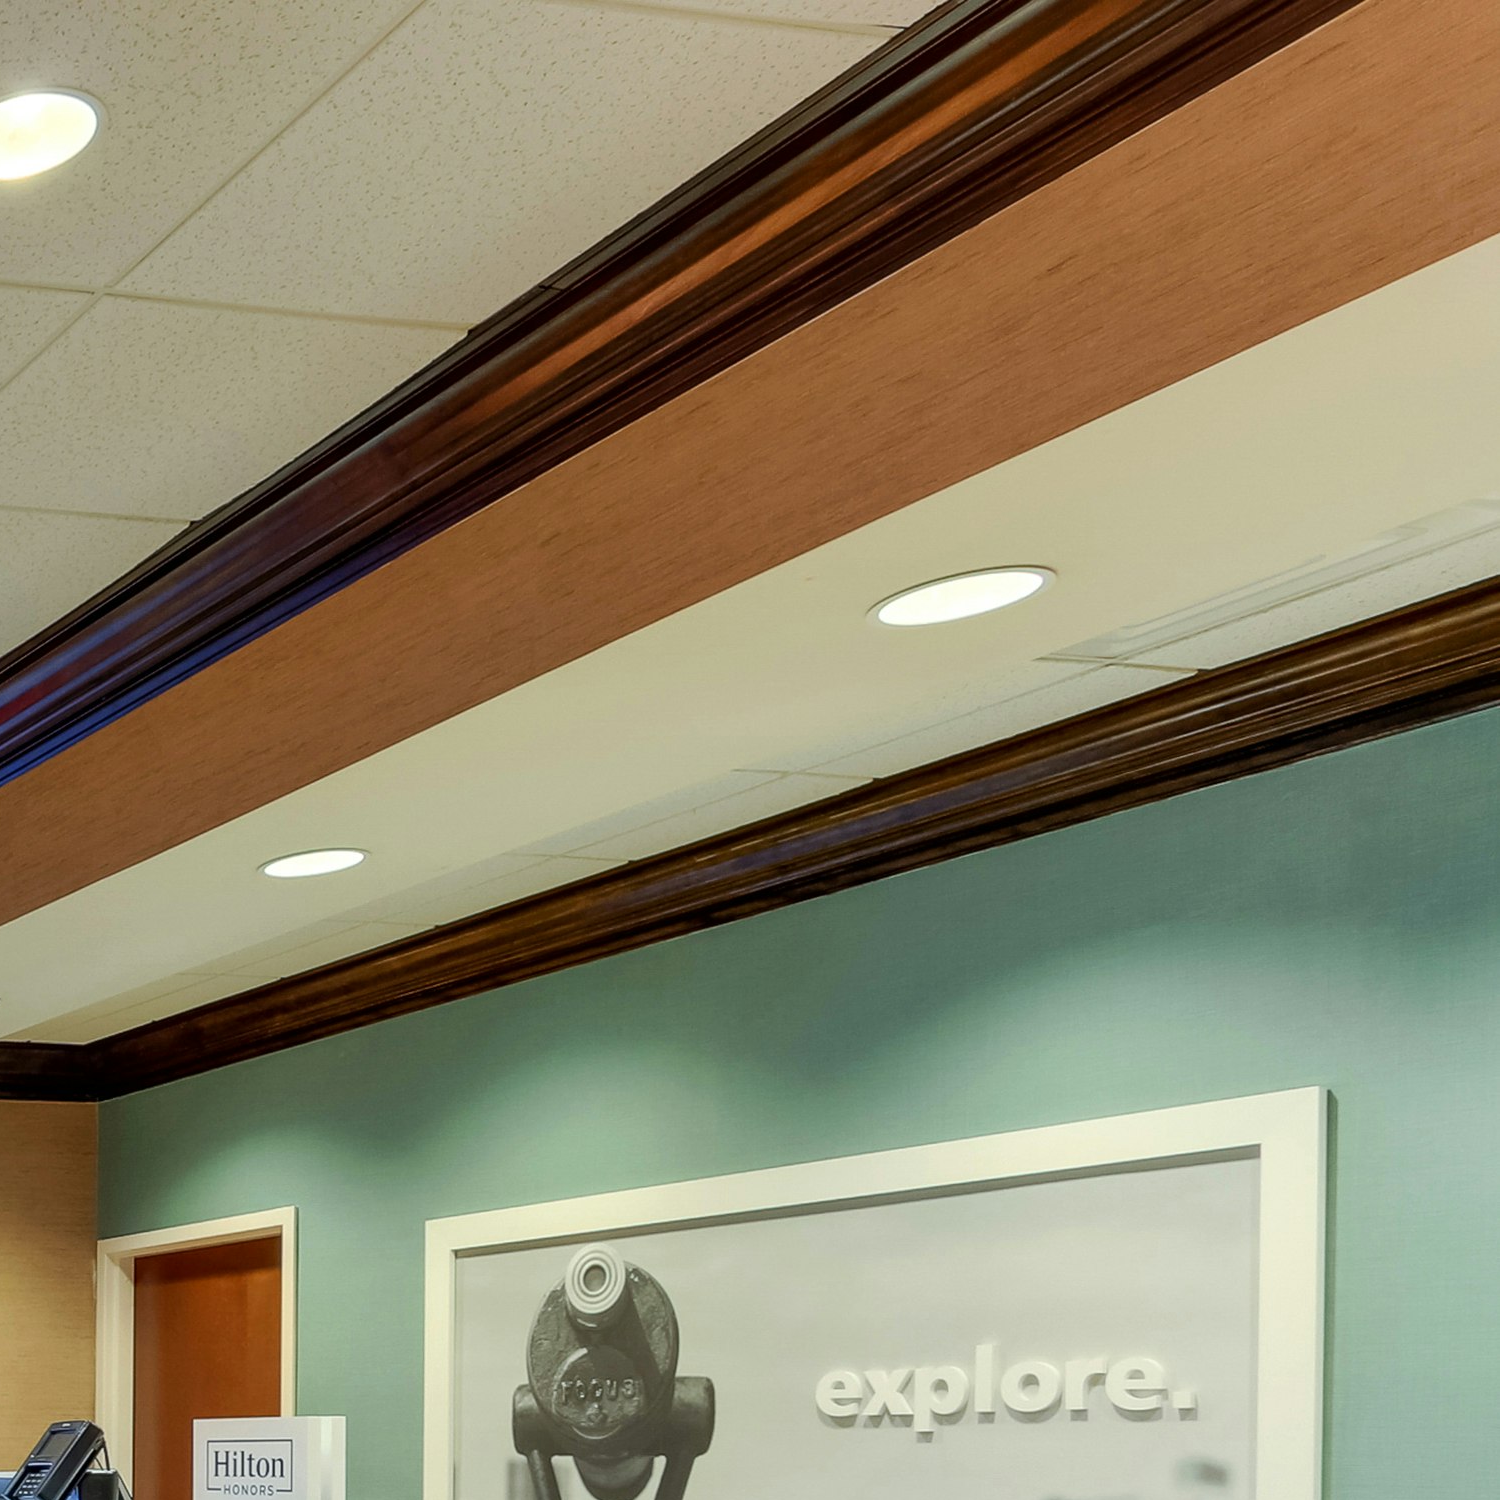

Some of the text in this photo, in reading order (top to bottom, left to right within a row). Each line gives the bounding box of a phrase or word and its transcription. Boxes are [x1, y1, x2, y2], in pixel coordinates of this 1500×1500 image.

[815, 1343, 1196, 1434] explore.
[213, 1450, 285, 1478] Hilton
[223, 1484, 275, 1496] HONORS
